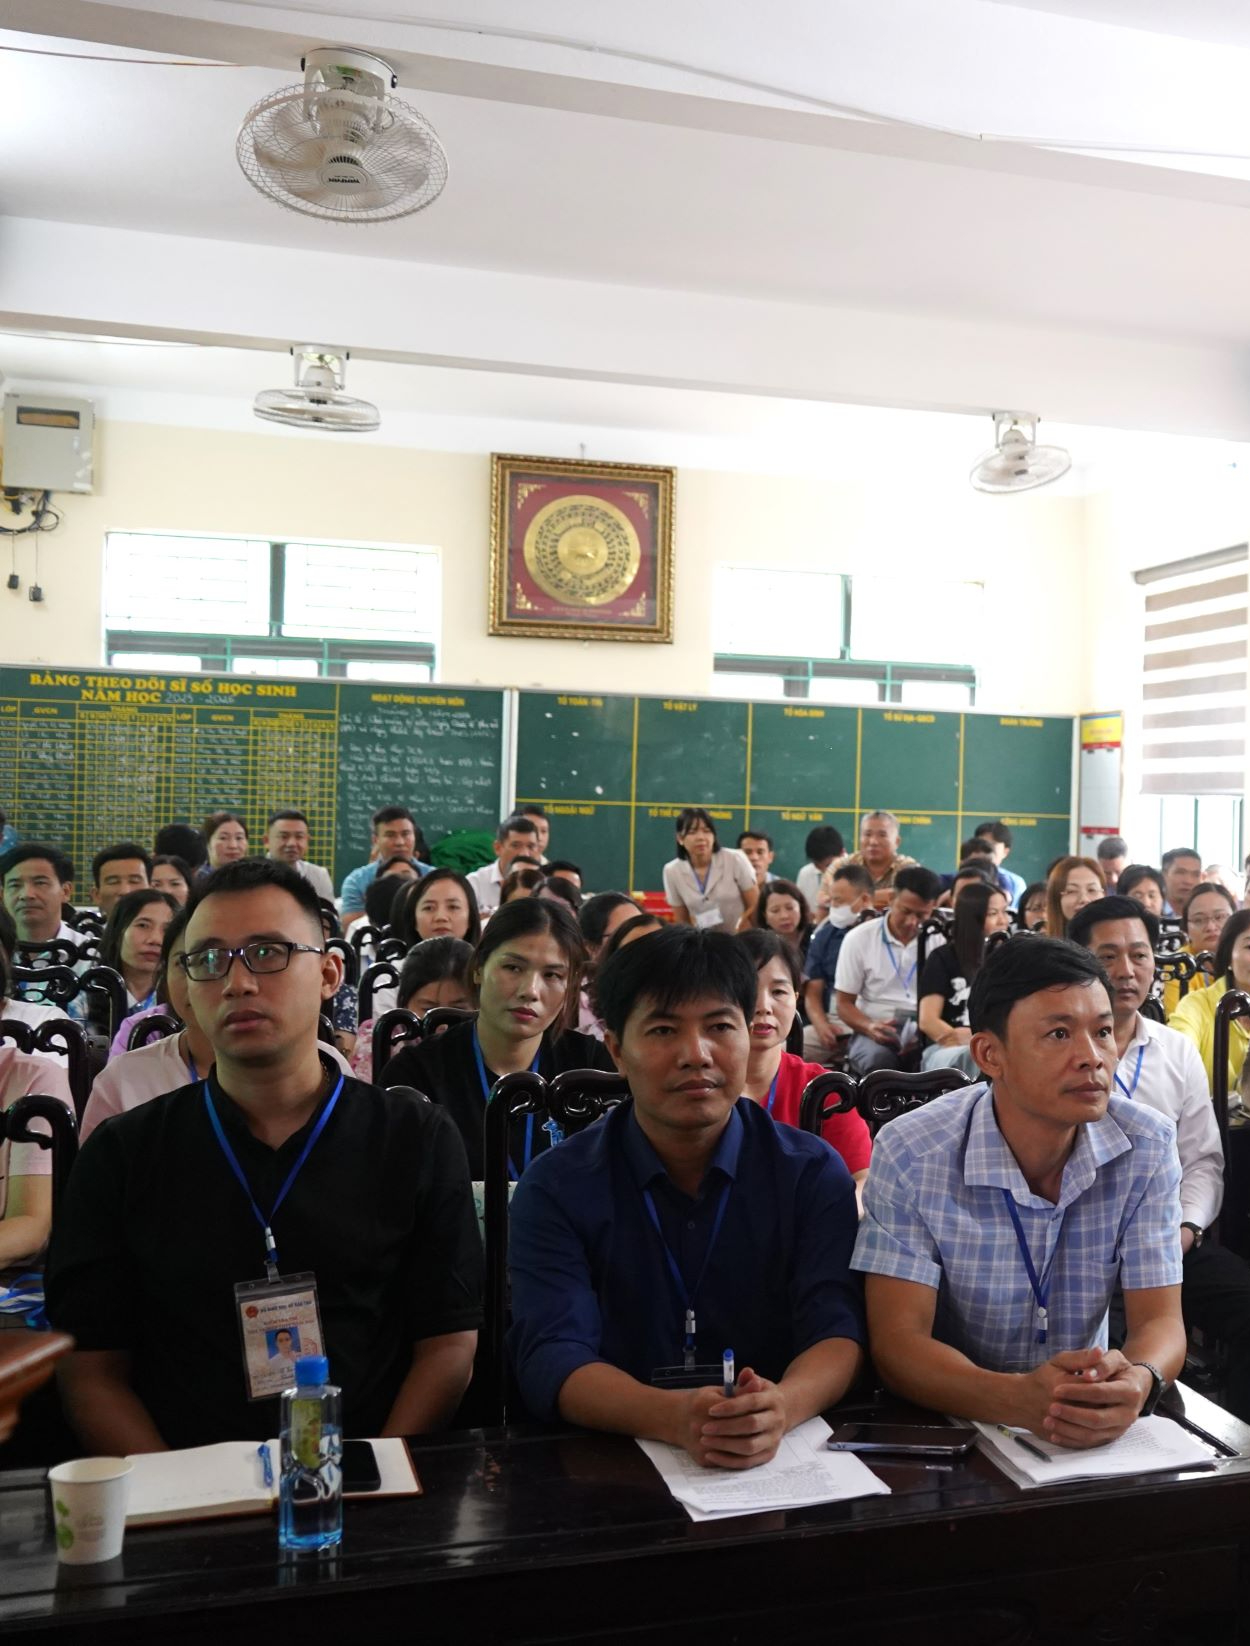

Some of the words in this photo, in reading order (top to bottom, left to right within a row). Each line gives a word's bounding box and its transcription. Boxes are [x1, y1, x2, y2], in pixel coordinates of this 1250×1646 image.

[30, 671, 80, 686] BẢNG
[85, 676, 132, 689] THEO
[191, 678, 213, 693] SỐ
[218, 681, 253, 696] HỌC
[256, 684, 297, 697] SINH
[126, 690, 161, 704] HỌC
